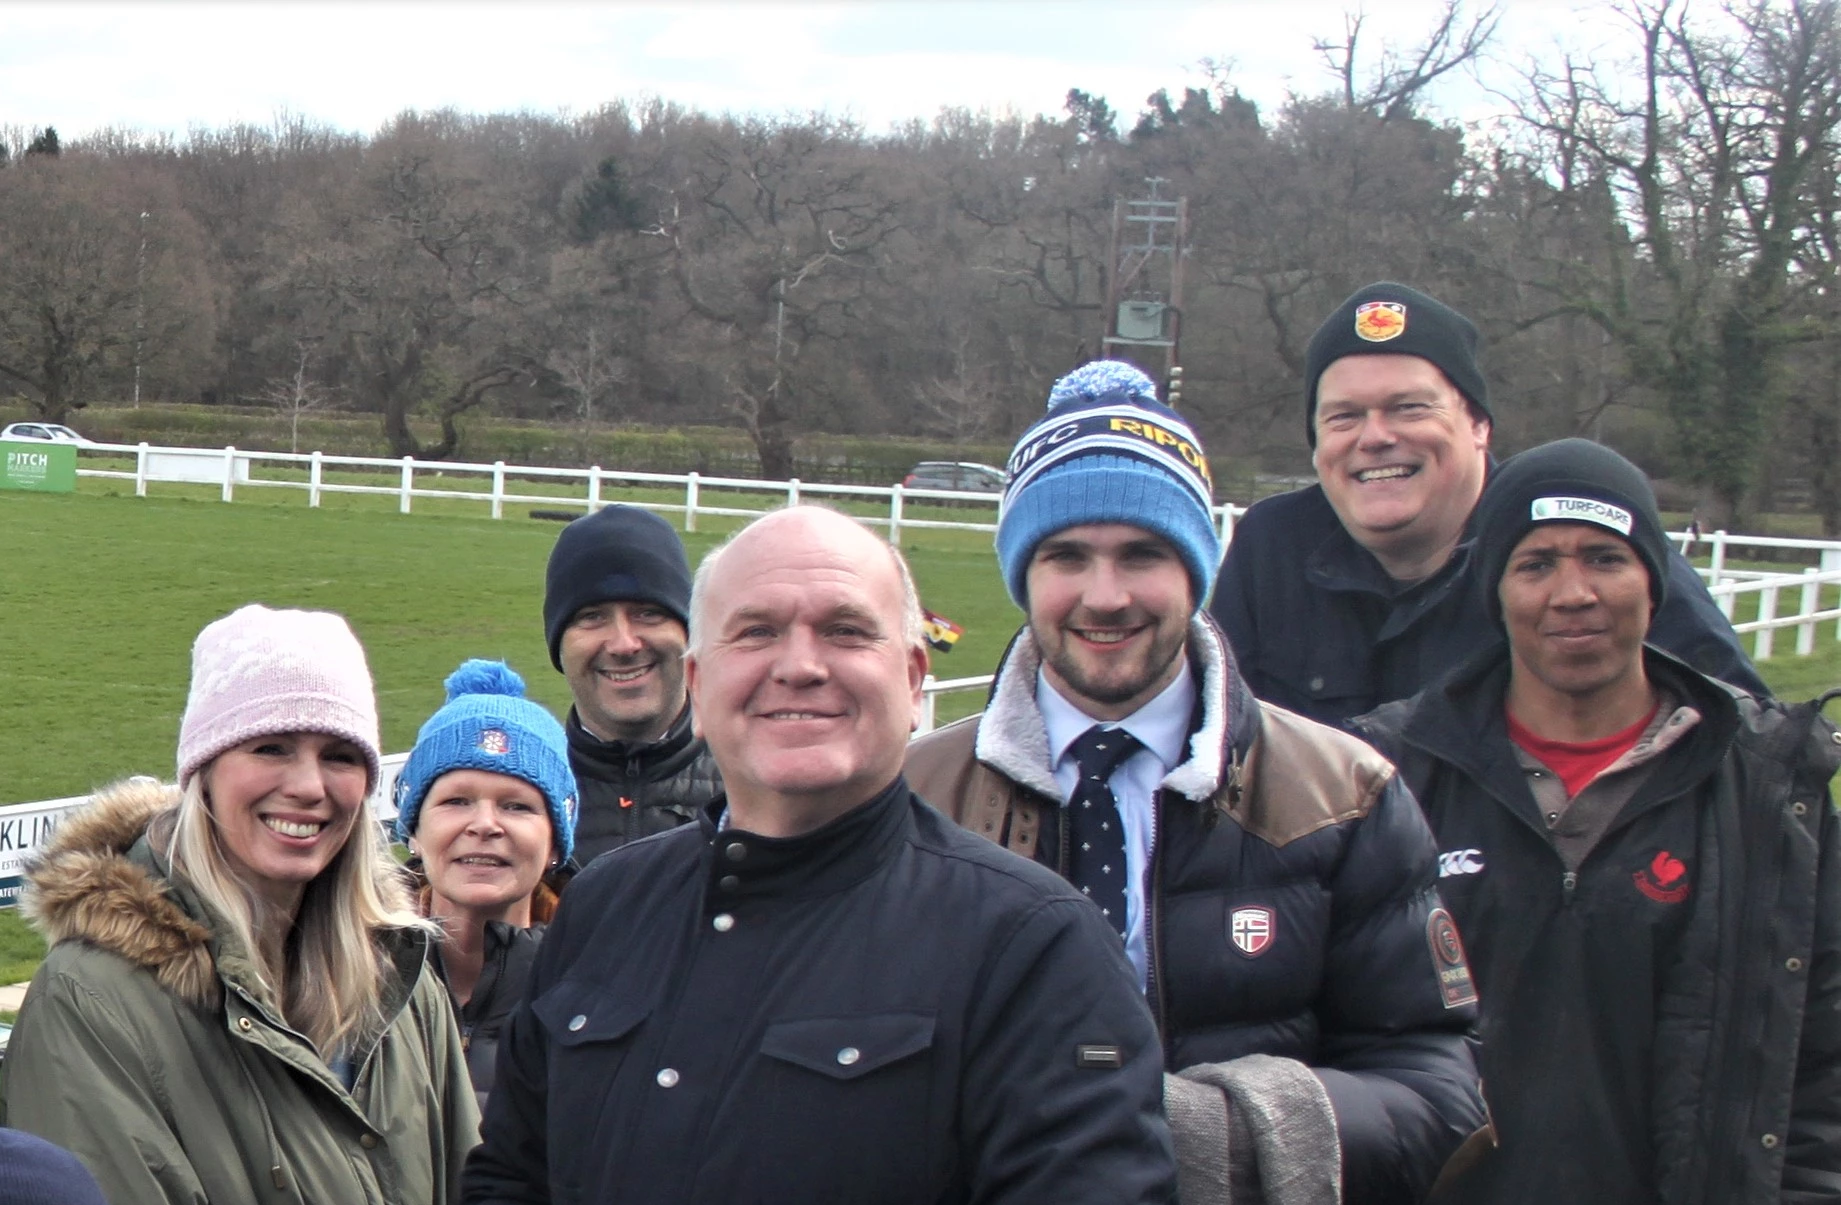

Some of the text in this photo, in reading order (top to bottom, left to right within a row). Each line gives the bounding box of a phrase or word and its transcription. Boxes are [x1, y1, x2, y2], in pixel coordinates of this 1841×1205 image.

[7, 452, 48, 466] PITCH
[1009, 424, 1079, 475] UFC
[1554, 499, 1630, 526] TURFCARE
[2, 859, 24, 870] ESTA
